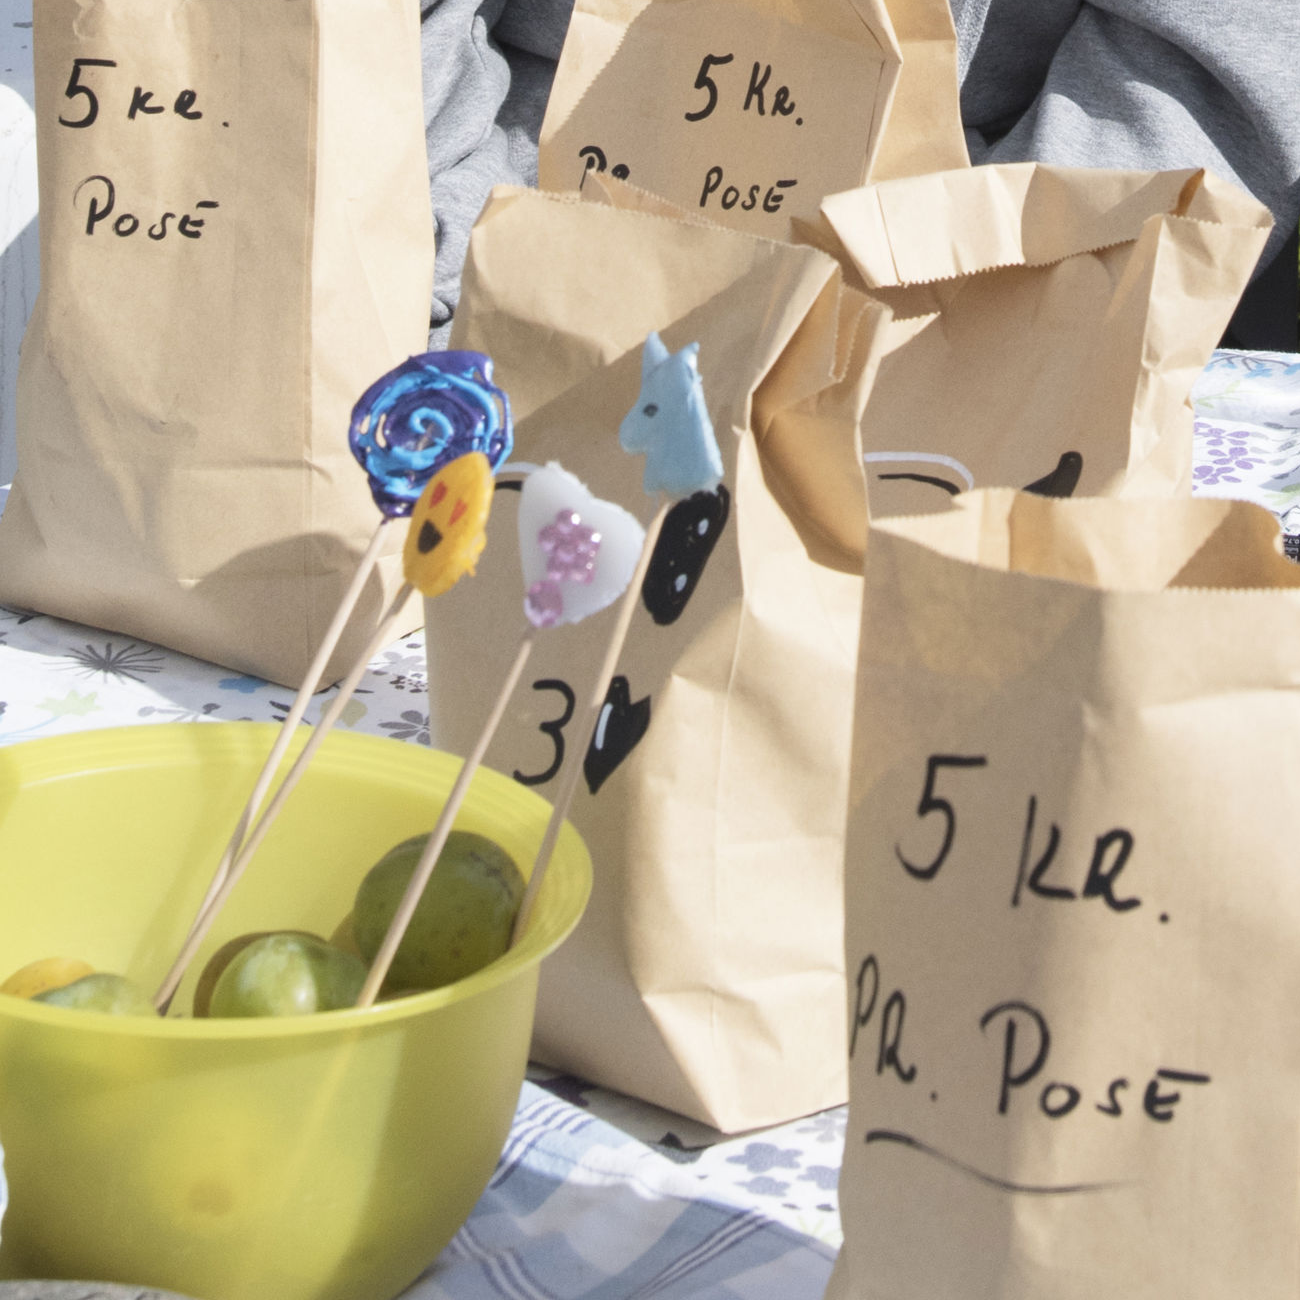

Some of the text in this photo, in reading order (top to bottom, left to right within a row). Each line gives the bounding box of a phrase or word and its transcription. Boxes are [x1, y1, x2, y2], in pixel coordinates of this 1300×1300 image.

[58, 58, 117, 128] 5
[684, 53, 734, 122] 5
[895, 755, 987, 880] 5
